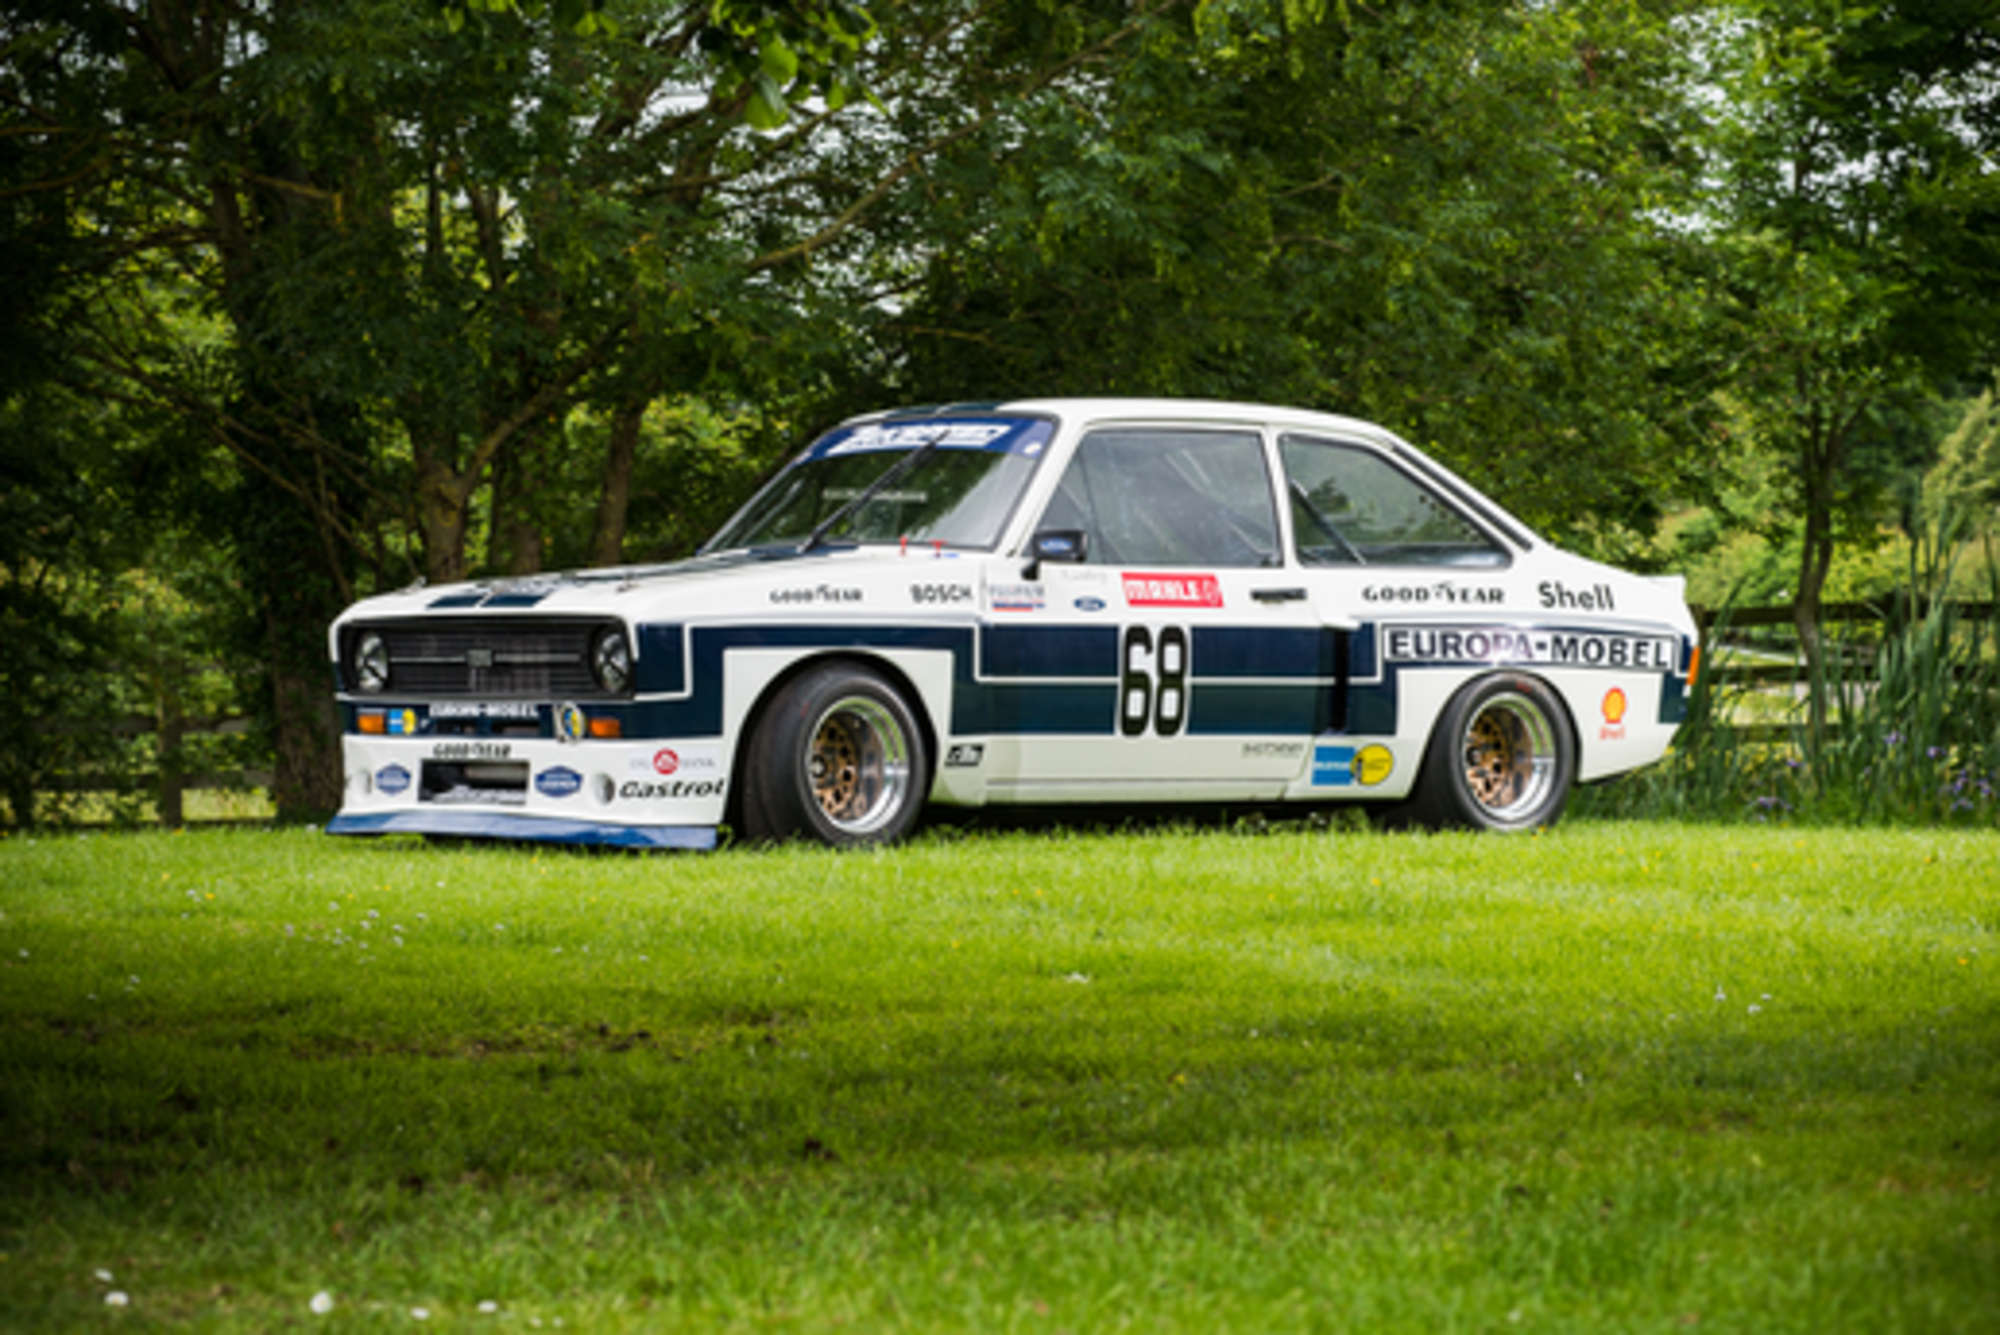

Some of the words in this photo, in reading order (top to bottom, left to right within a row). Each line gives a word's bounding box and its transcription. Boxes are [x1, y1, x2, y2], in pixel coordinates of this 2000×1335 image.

[910, 583, 974, 604] BOSCH
[1538, 582, 1615, 610] Shell
[1120, 625, 1188, 737] 68
[619, 778, 724, 799] Castrol
